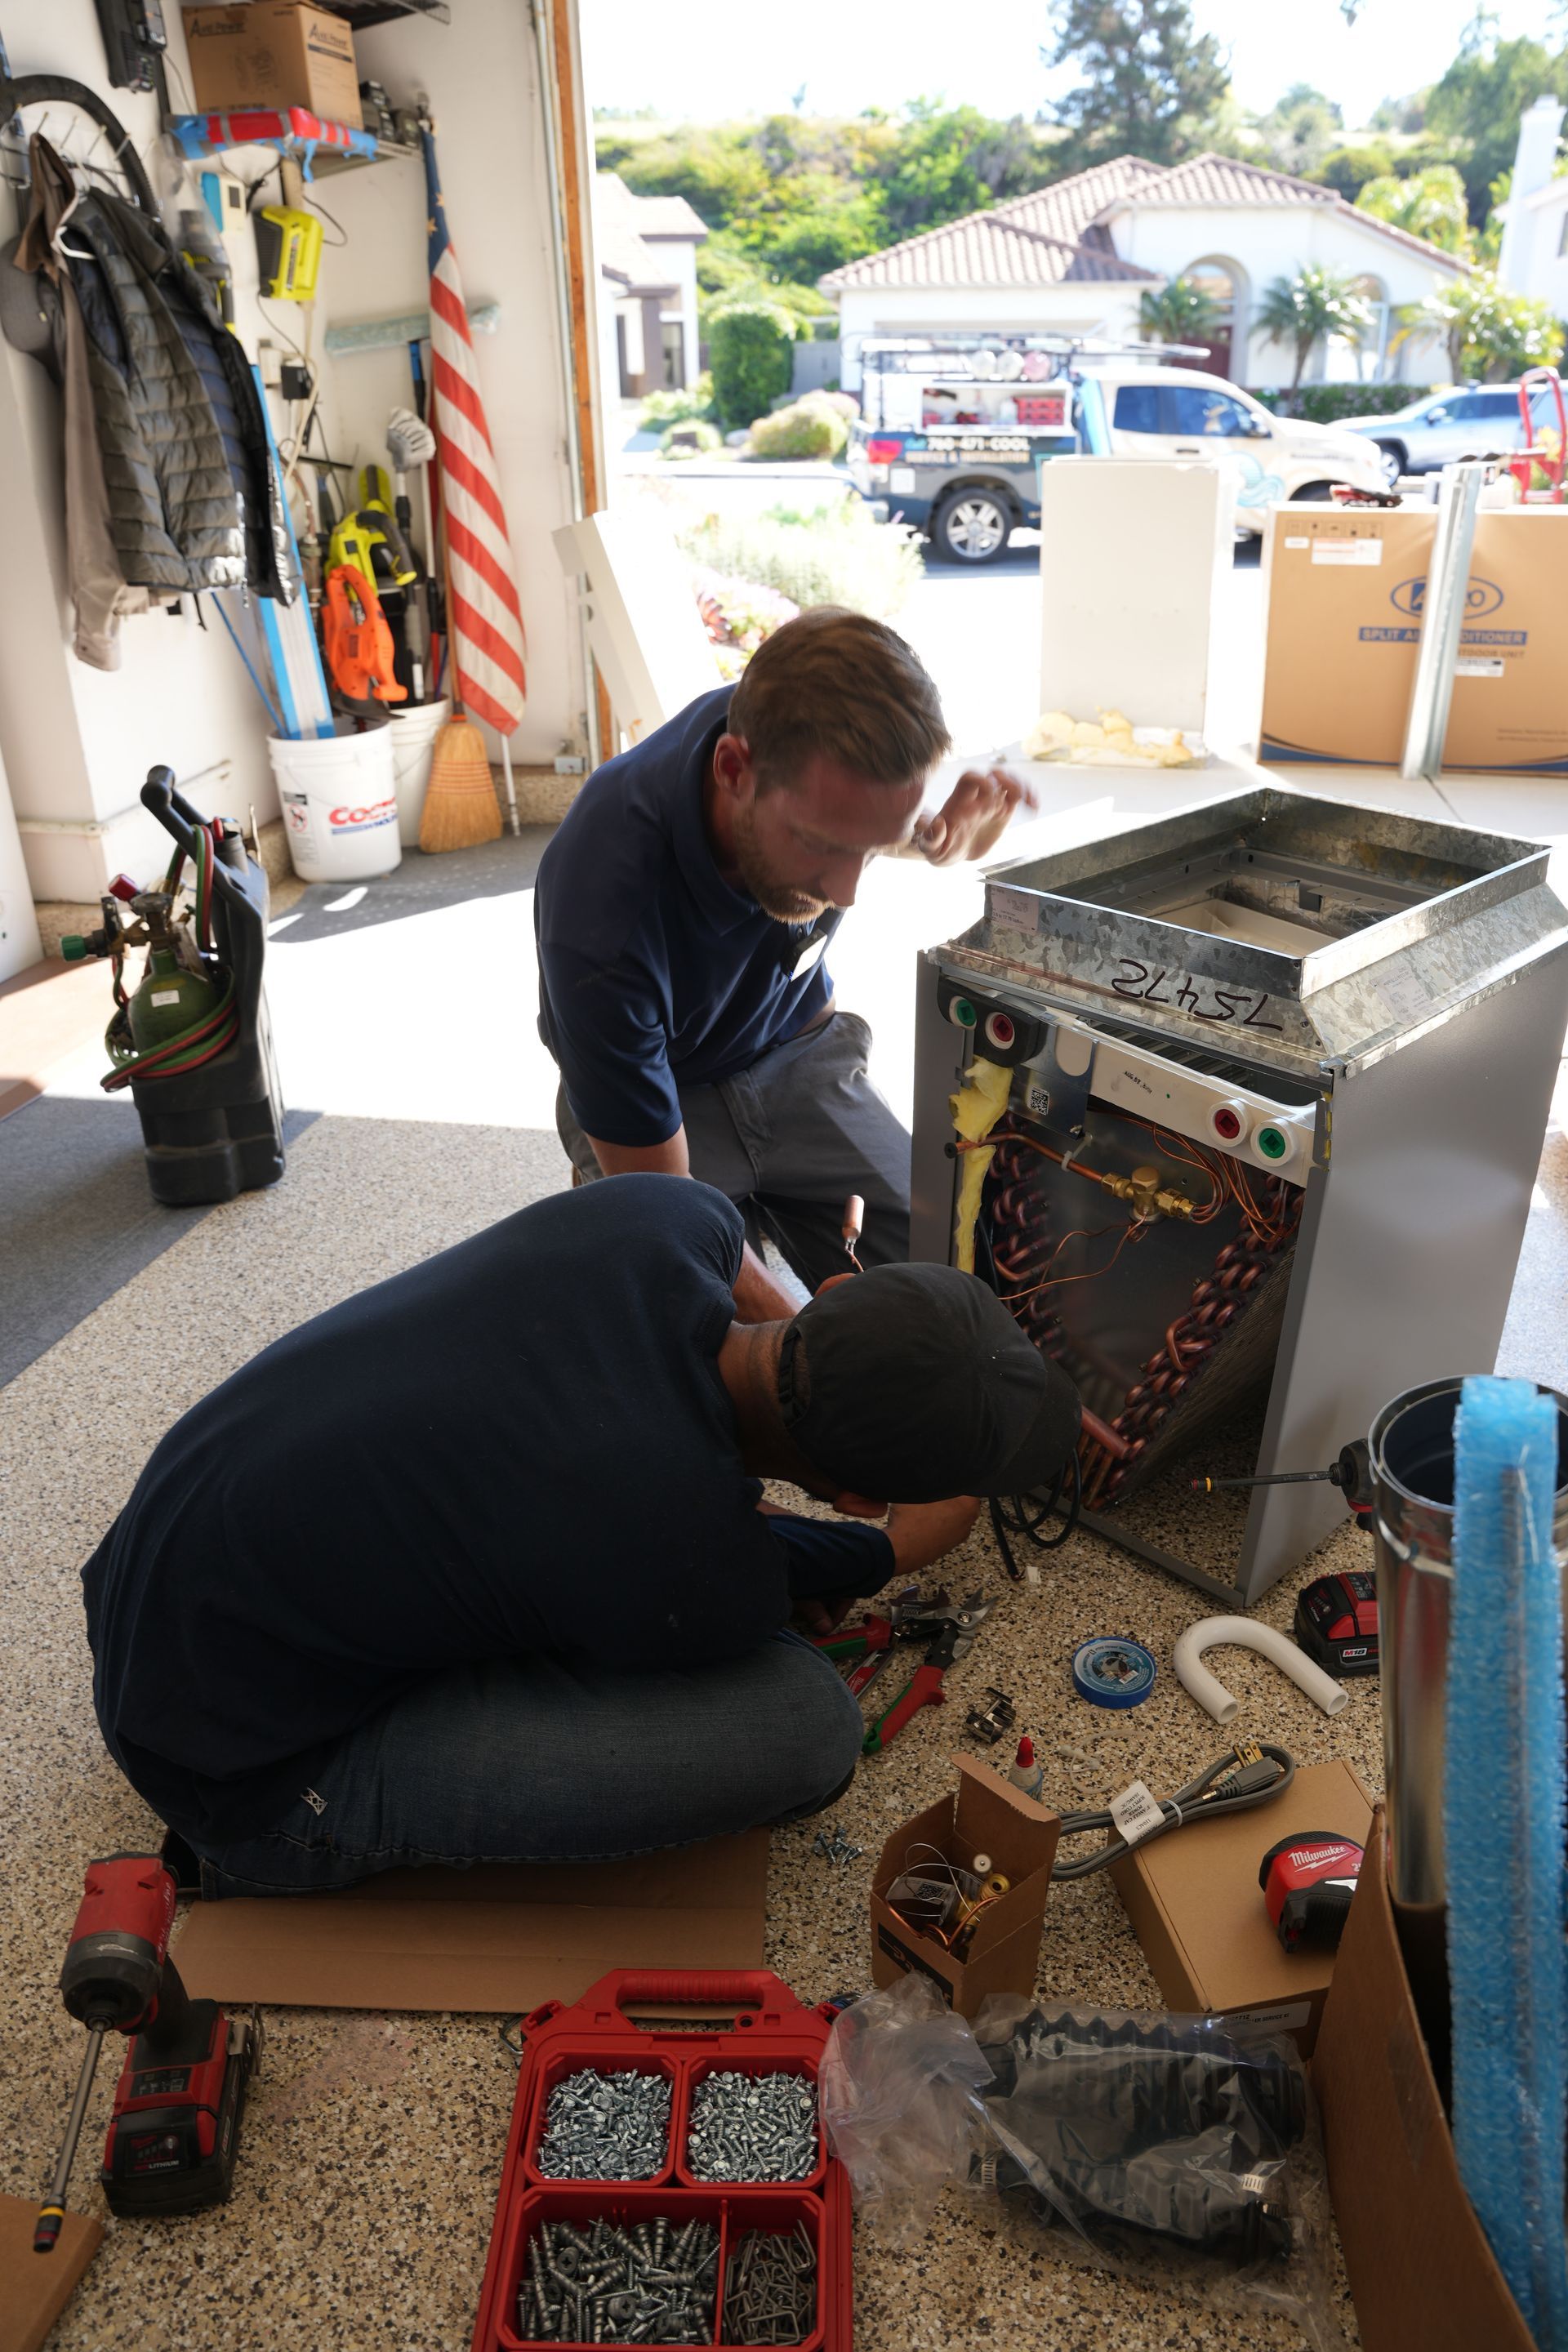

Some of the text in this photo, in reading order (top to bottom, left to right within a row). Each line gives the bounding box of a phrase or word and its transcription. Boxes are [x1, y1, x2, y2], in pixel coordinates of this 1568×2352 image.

[1362, 628, 1400, 640] SPLIT
[1111, 958, 1283, 1031] 75472
[1344, 1648, 1365, 1656] M18
[1120, 1806, 1133, 1816] CORD
[1128, 1804, 1143, 1816] POWER
[1288, 1846, 1346, 1867] Milwaukee
